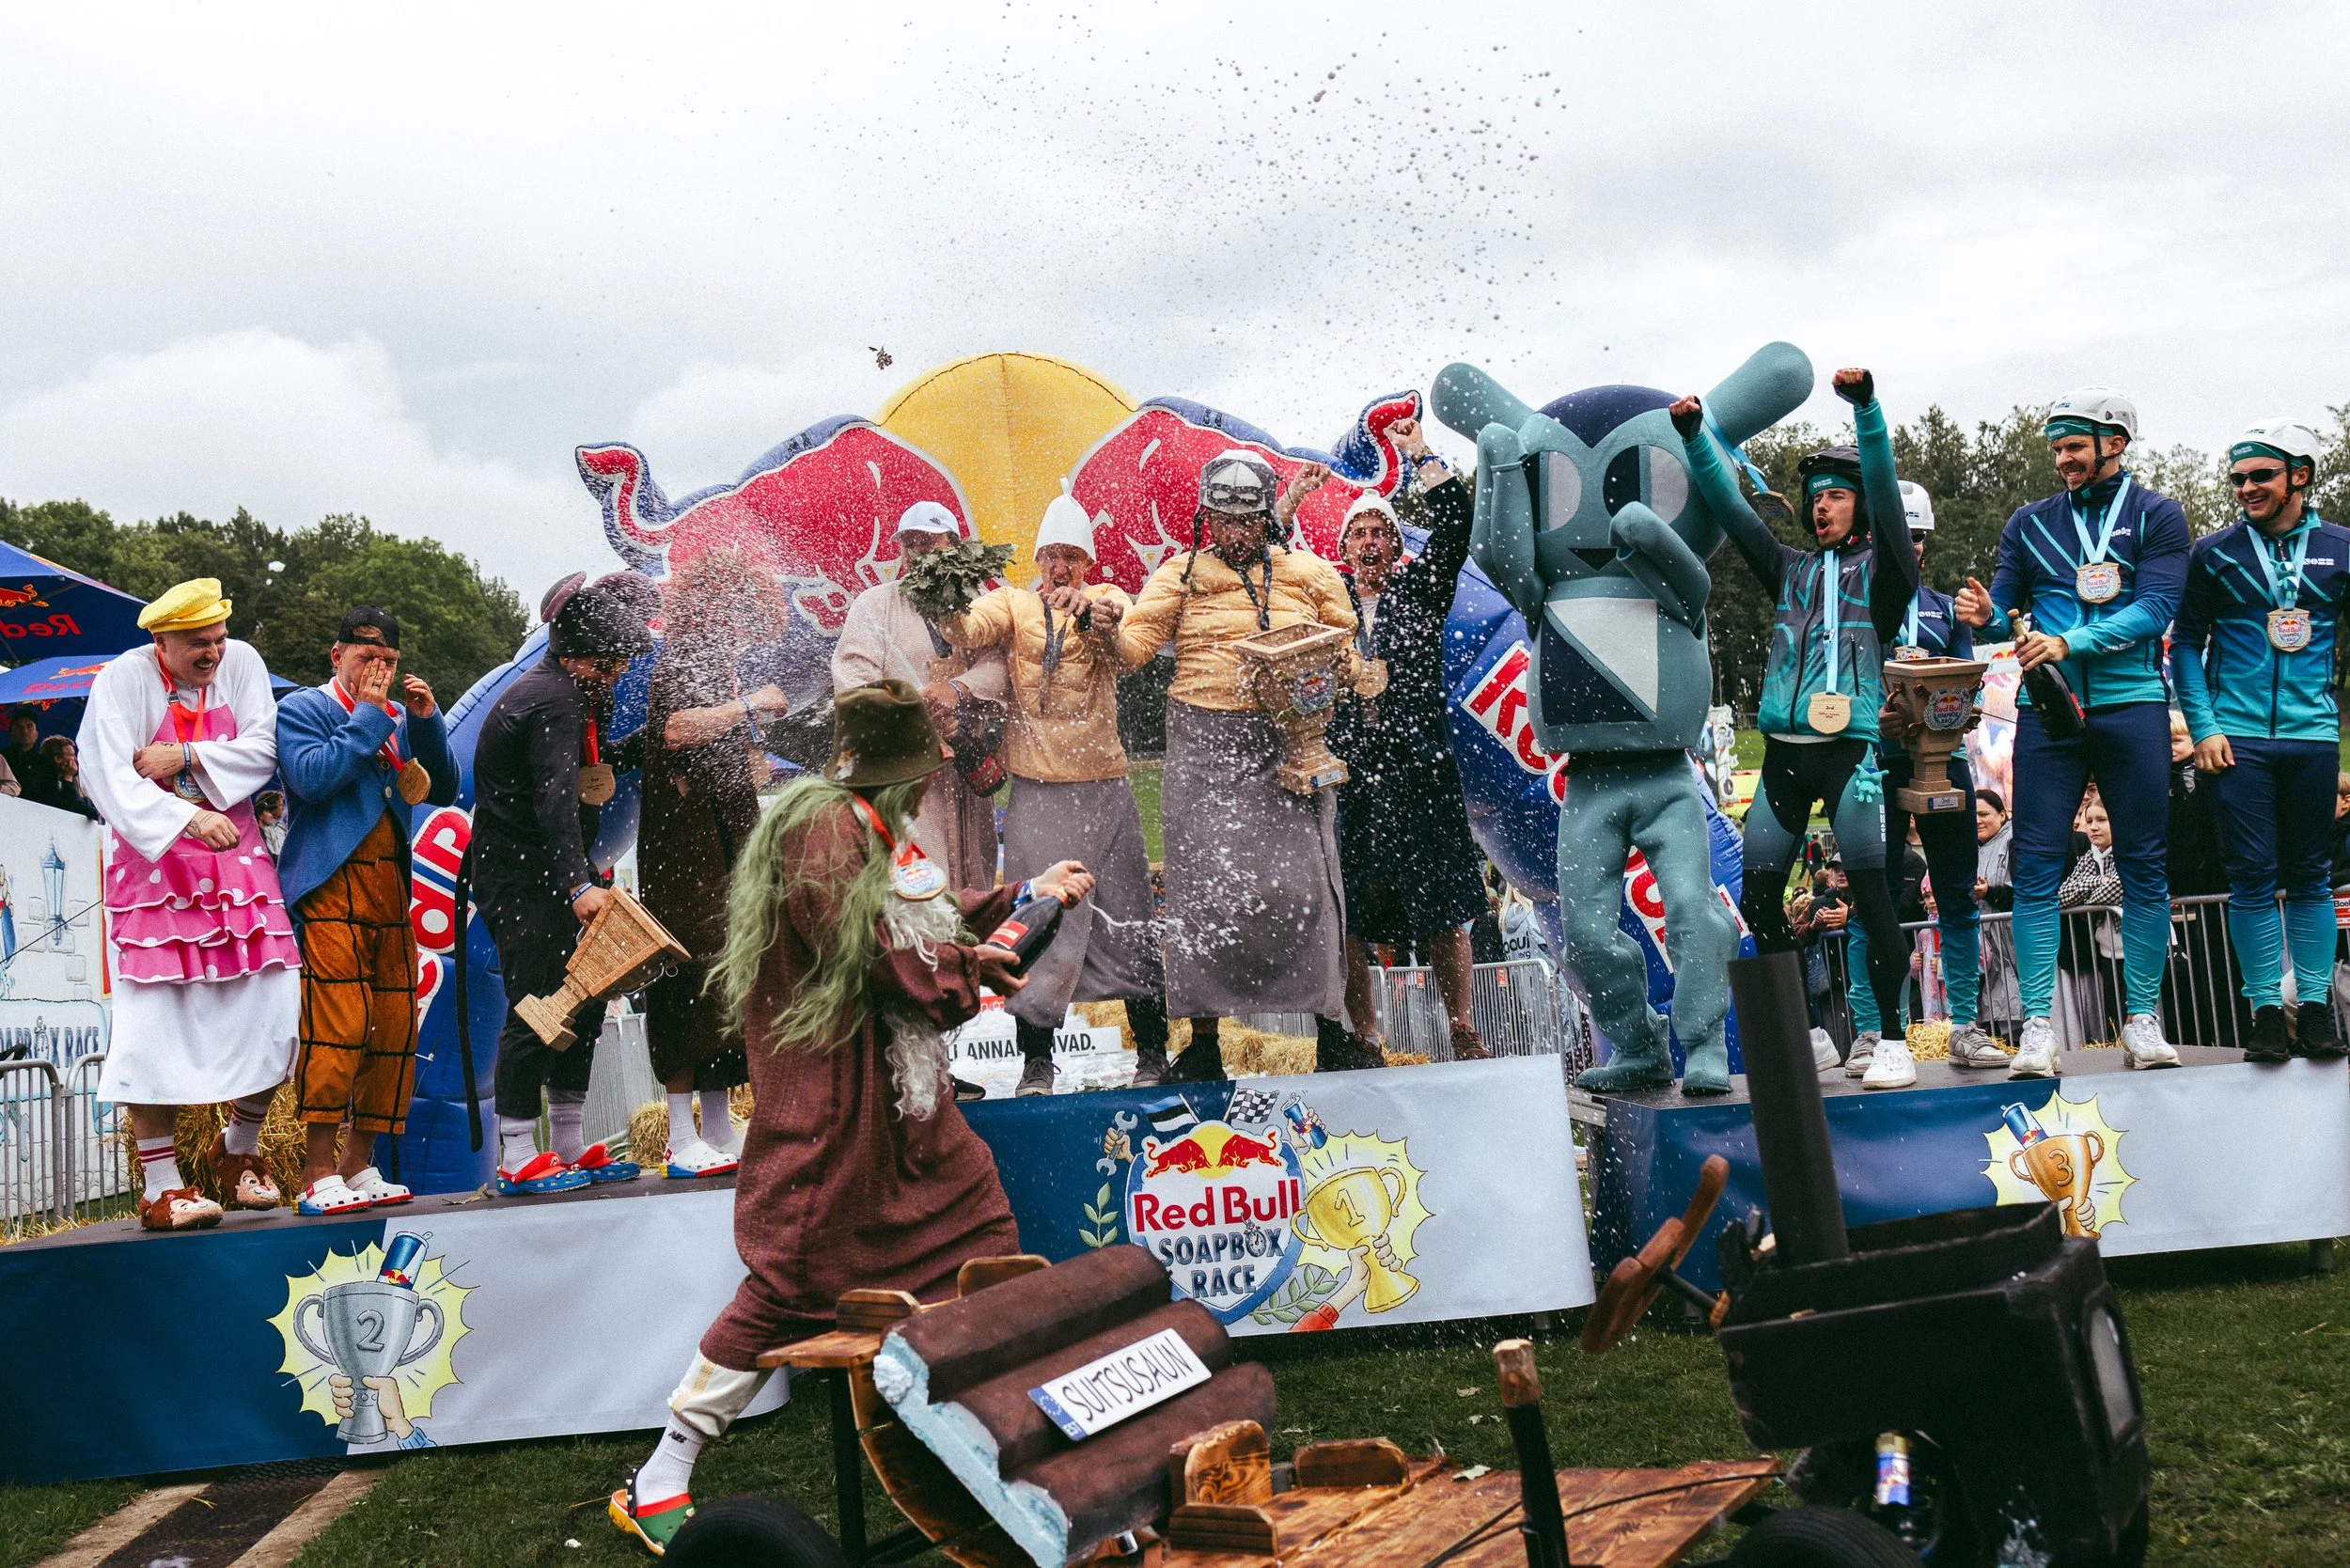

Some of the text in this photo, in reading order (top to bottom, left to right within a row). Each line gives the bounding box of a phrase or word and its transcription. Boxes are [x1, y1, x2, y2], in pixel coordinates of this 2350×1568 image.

[1935, 702, 1963, 713] Red Bull
[2048, 1149, 2074, 1185] 3
[1134, 1179, 1301, 1232] Red Bull
[1335, 1188, 1366, 1228] 1
[1158, 1228, 1284, 1266] SOAPBOX
[1192, 1265, 1257, 1298] RACE
[356, 1309, 385, 1353] 2
[1062, 1336, 1194, 1421] SUITSUSAUN
